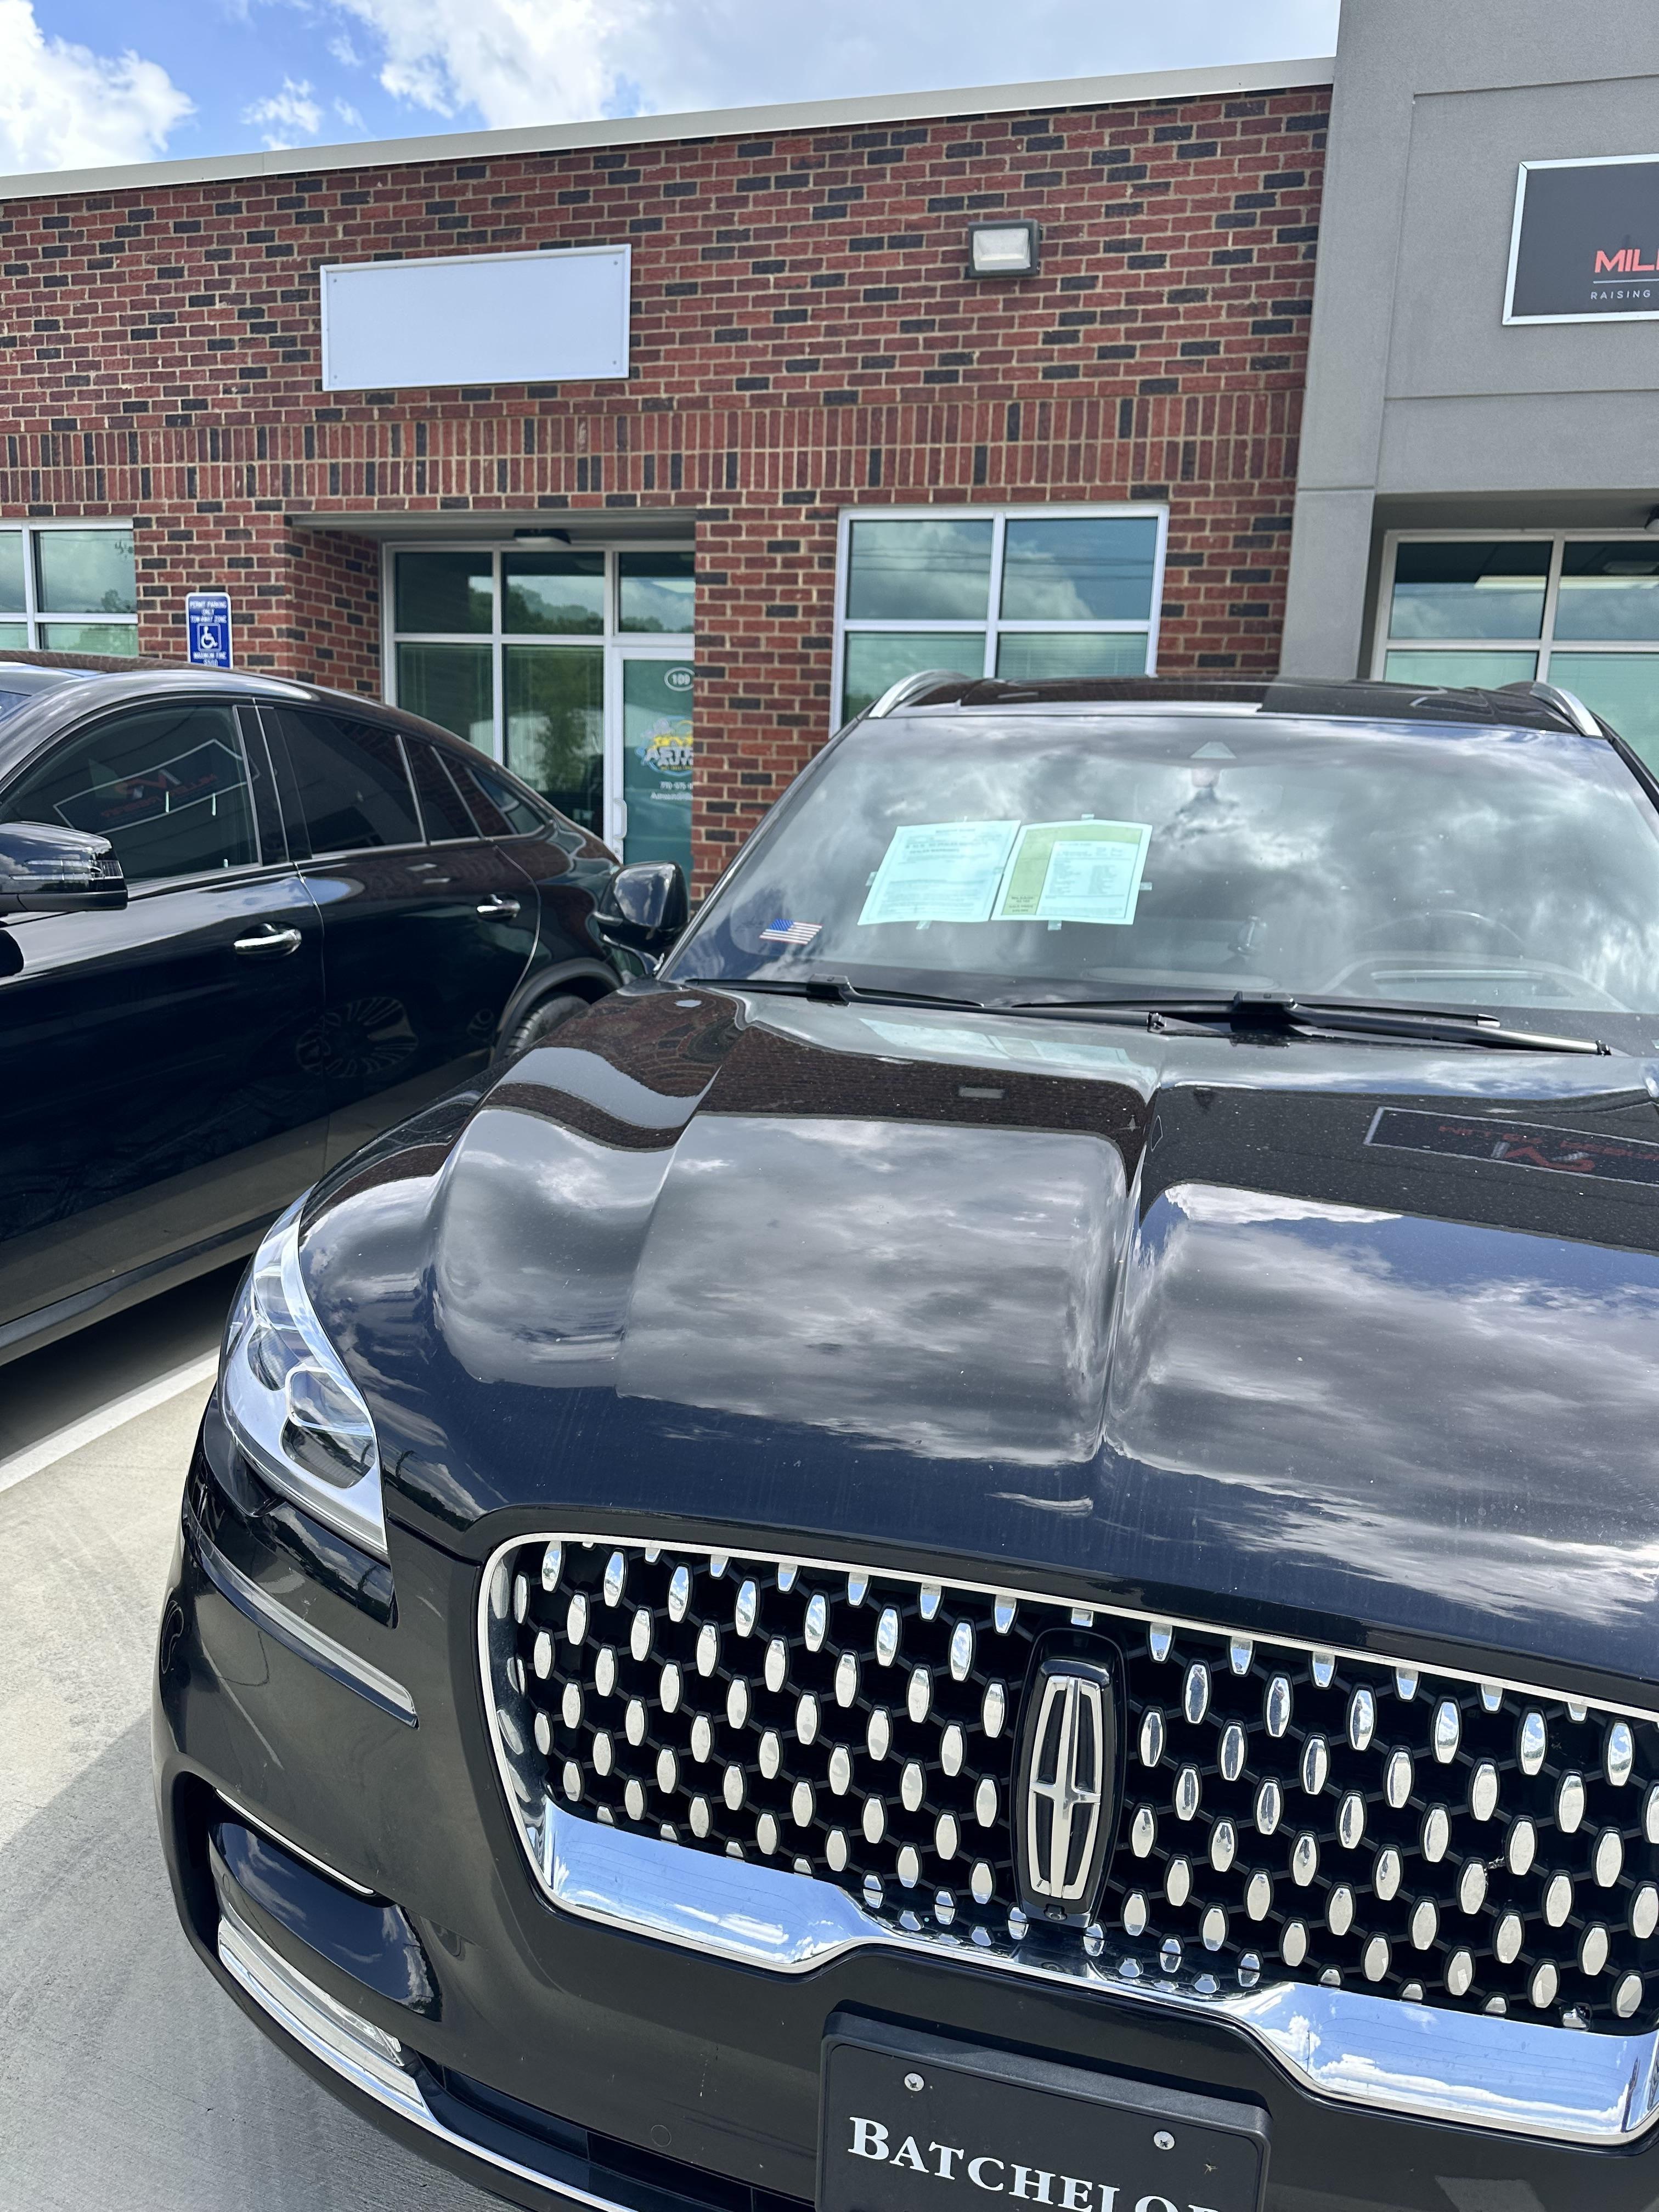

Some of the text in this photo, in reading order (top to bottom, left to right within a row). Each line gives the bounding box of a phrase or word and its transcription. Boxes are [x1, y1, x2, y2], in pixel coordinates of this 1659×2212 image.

[1594, 249, 1659, 273] MIL
[1591, 290, 1651, 300] RAISING
[848, 2116, 1220, 2212] BATCHEL
